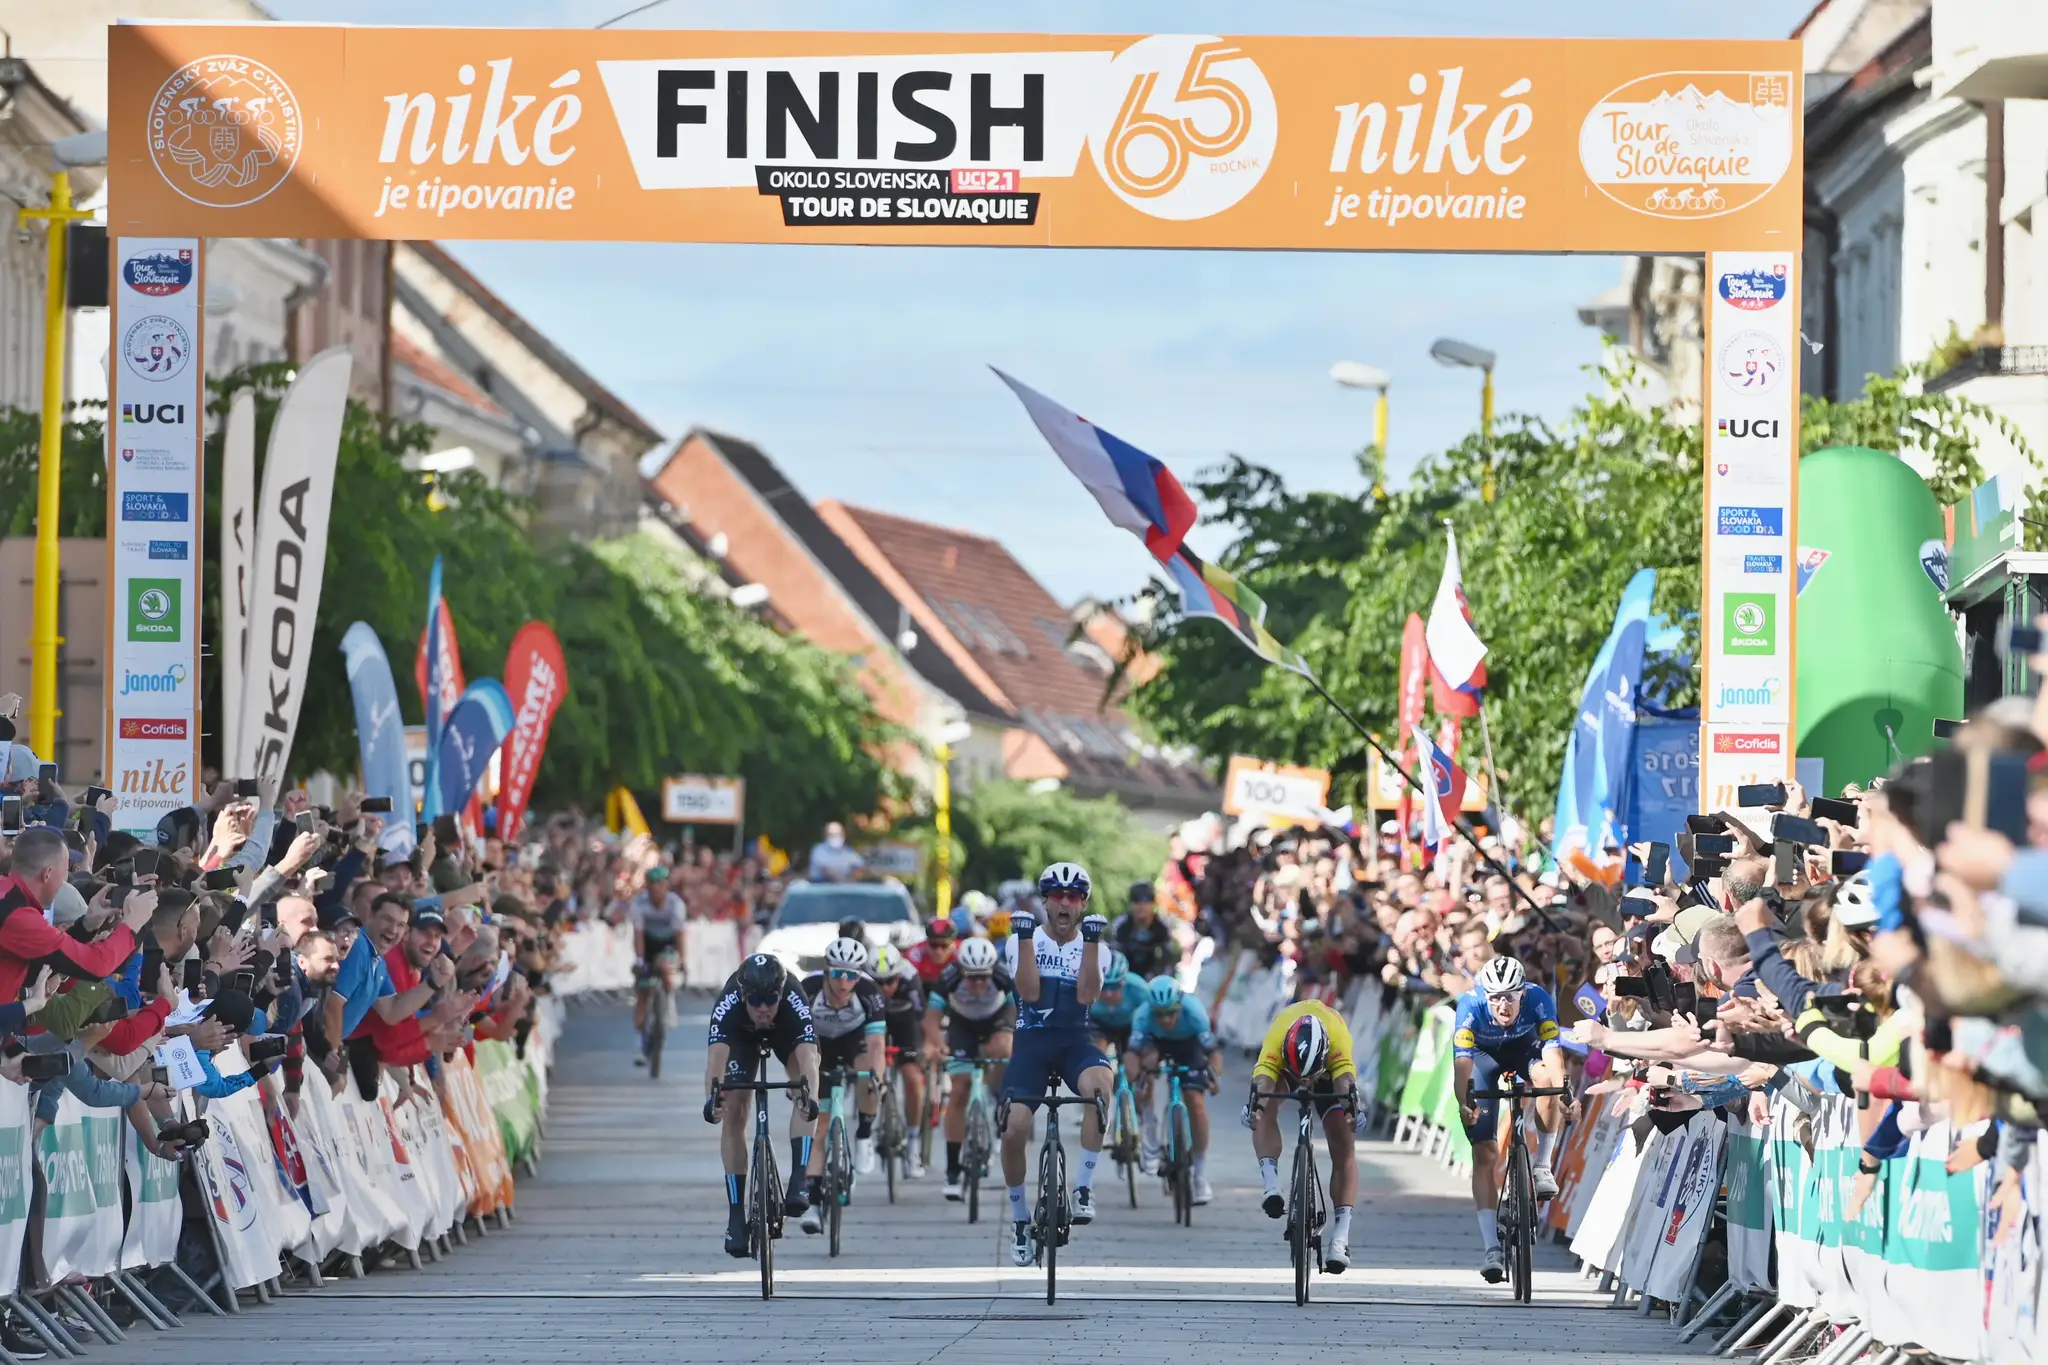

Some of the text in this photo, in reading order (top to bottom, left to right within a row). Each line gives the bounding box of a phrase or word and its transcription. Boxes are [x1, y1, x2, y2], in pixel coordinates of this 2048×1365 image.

[154, 65, 201, 150] SLOVENSKÝ
[252, 69, 297, 153] CYKLISTIKY
[377, 56, 582, 166] niké
[656, 70, 1044, 162] FINISH
[1104, 43, 1252, 198] 65
[1329, 66, 1533, 175] niké
[1602, 112, 1669, 144] Tour
[1655, 135, 1680, 156] de
[1616, 144, 1751, 185] Slovaquie
[769, 171, 830, 189] OKOLO
[834, 172, 941, 190] SLOVENSKA
[375, 176, 576, 218] je tipovanie
[1324, 185, 1526, 226] je tipovanie
[788, 197, 1029, 223] TOUR DE SLOVAQUIE
[130, 260, 153, 273] Tour
[134, 271, 180, 287] Slovaquie
[1724, 275, 1748, 288] Tour
[134, 403, 184, 424] UCI
[1729, 419, 1778, 438] UCI
[125, 494, 154, 502] SPORT
[125, 502, 167, 511] SLOVAKIA
[1720, 508, 1759, 518] SPORT &
[1720, 516, 1762, 525] SLOVAKIA
[120, 668, 177, 696] janom
[1716, 683, 1771, 709] janom
[141, 724, 184, 735] Cofidis
[1735, 738, 1778, 750] Cofidis
[120, 758, 187, 794] niké
[1244, 780, 1286, 805] 100
[120, 797, 184, 810] je tipovanie
[1035, 953, 1064, 968] SRAEL
